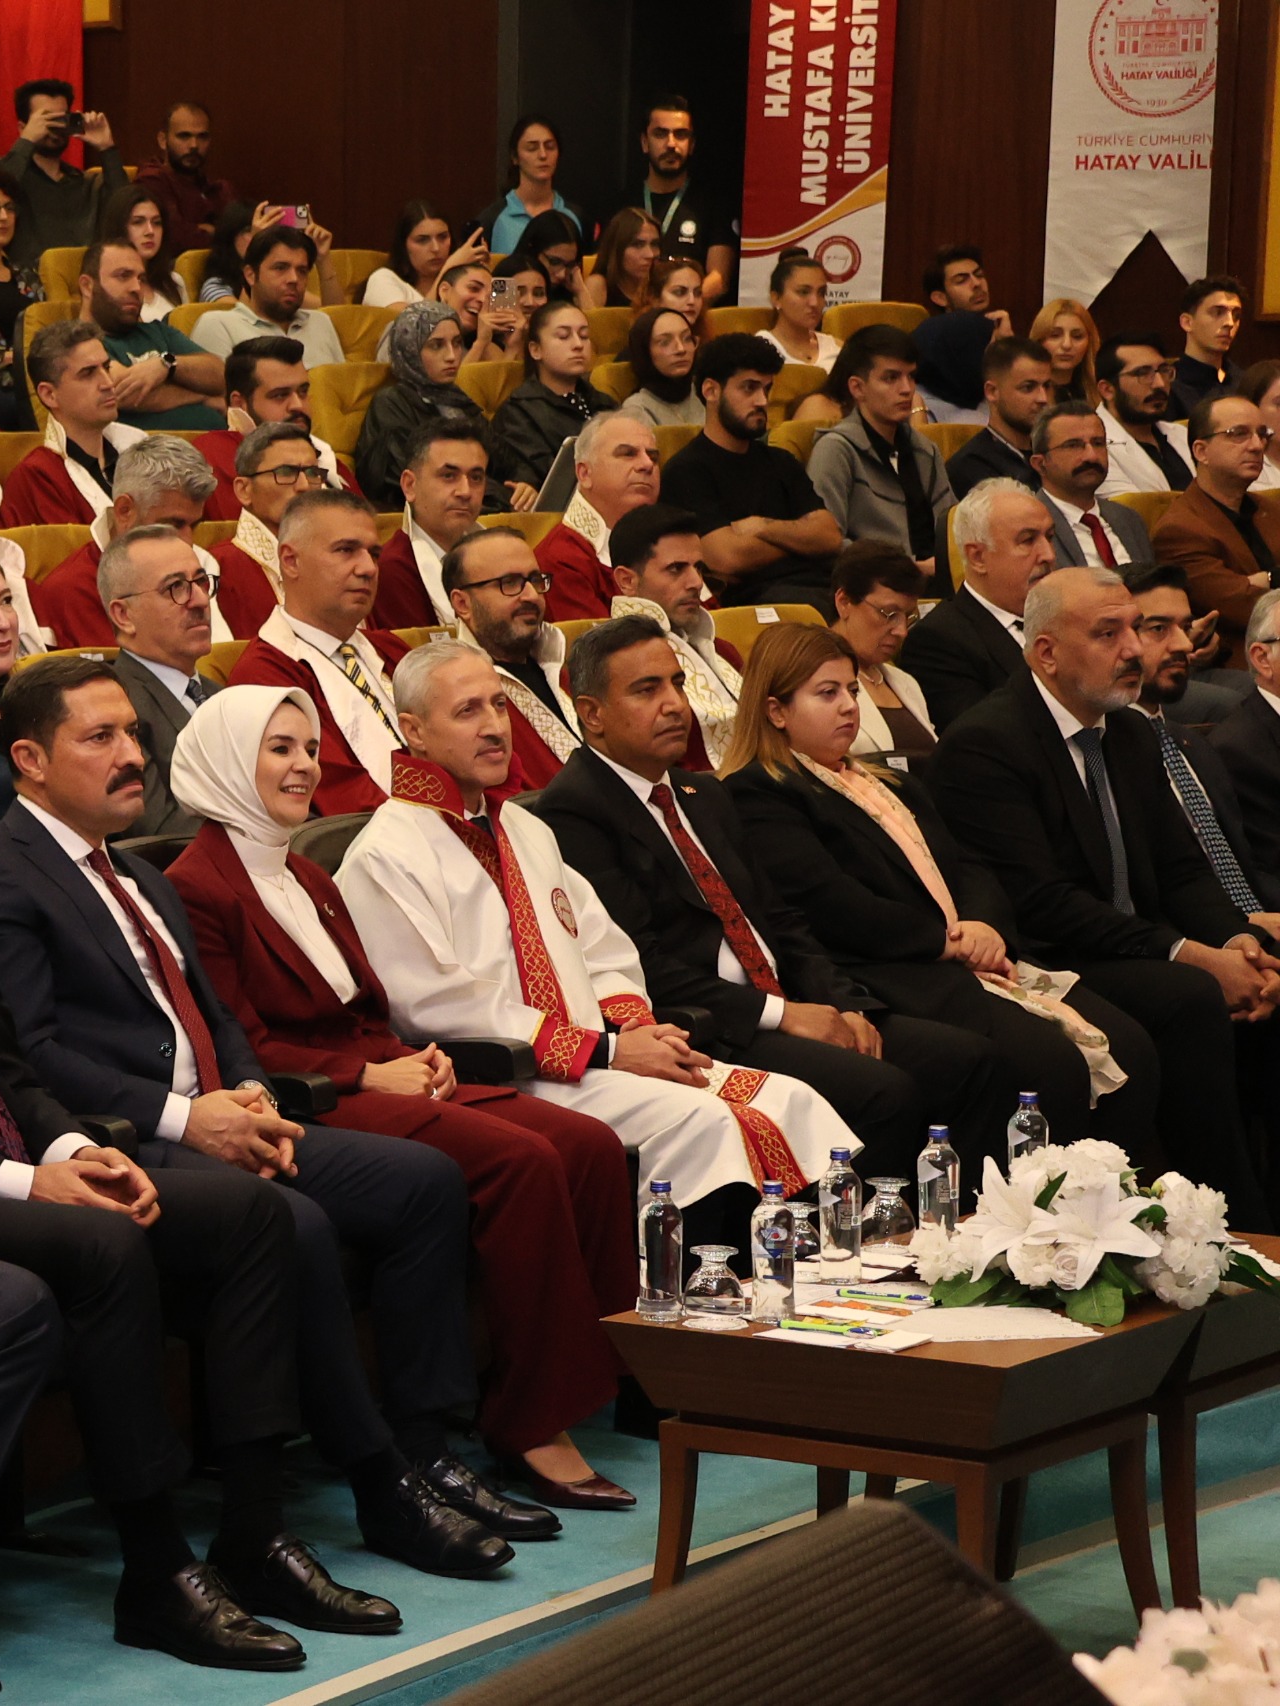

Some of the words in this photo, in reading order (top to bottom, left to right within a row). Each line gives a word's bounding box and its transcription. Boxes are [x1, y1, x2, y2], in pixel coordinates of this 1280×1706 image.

[764, 3, 795, 117] HATAY
[1121, 71, 1153, 80] HATAY
[800, 44, 835, 206] MUSTAFA
[1075, 154, 1141, 171] HATAY
